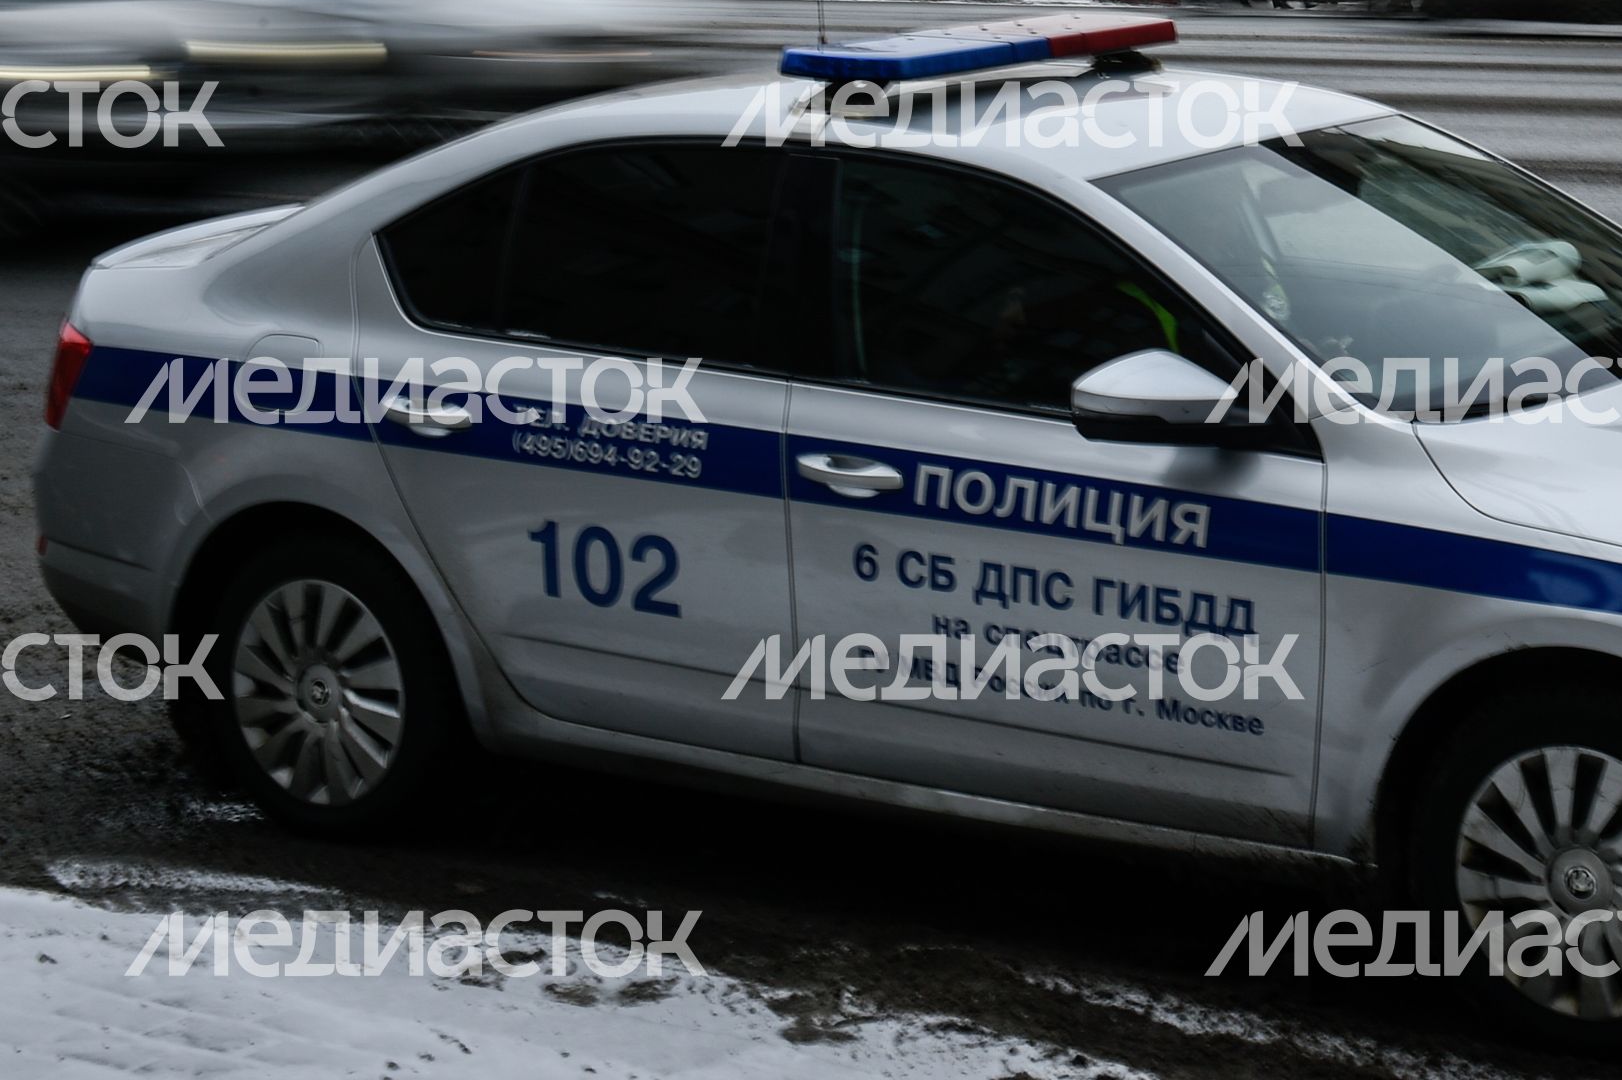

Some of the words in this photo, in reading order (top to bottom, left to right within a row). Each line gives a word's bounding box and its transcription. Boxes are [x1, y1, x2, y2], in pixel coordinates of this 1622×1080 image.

[512, 429, 703, 480] (495)694-92-29
[579, 416, 710, 451] ДОВЕРИЯ
[913, 461, 1211, 549] ПОЛИЦИЯ
[528, 520, 681, 618] 102
[853, 542, 880, 582] 6
[896, 549, 957, 593] СБ
[973, 562, 1075, 610] ДПС
[1094, 576, 1258, 637] ГИБДД
[932, 614, 973, 641] на
[1079, 688, 1114, 712] по
[1121, 694, 1145, 717] г.
[1156, 697, 1266, 737] Москве
